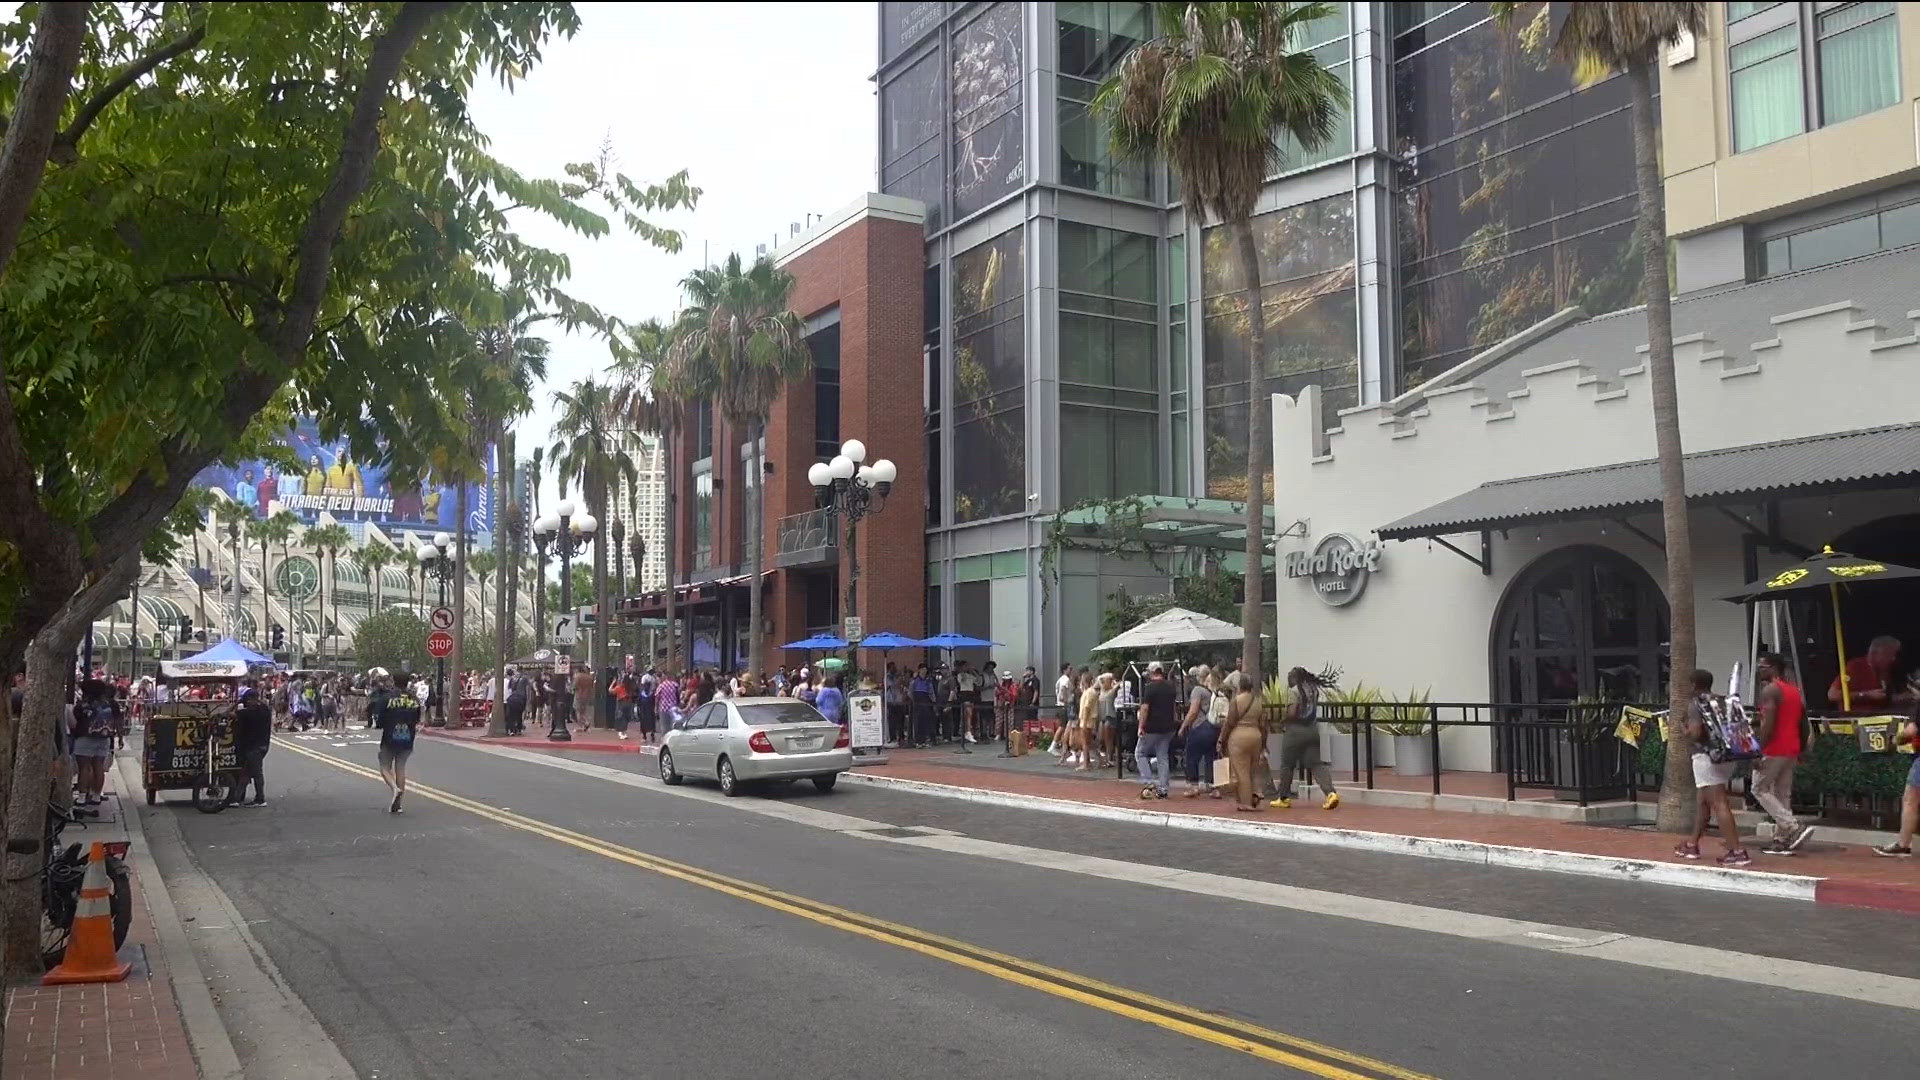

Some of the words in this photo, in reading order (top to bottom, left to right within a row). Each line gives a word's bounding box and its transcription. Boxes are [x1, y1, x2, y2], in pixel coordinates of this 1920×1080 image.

[280, 494, 326, 509] STRANGE
[327, 495, 352, 511] NEW
[353, 497, 395, 513] WORLDS
[1285, 550, 1328, 578] Hard
[1330, 541, 1381, 576] Rock
[1320, 581, 1346, 592] HOTEL
[429, 639, 452, 650] STOP
